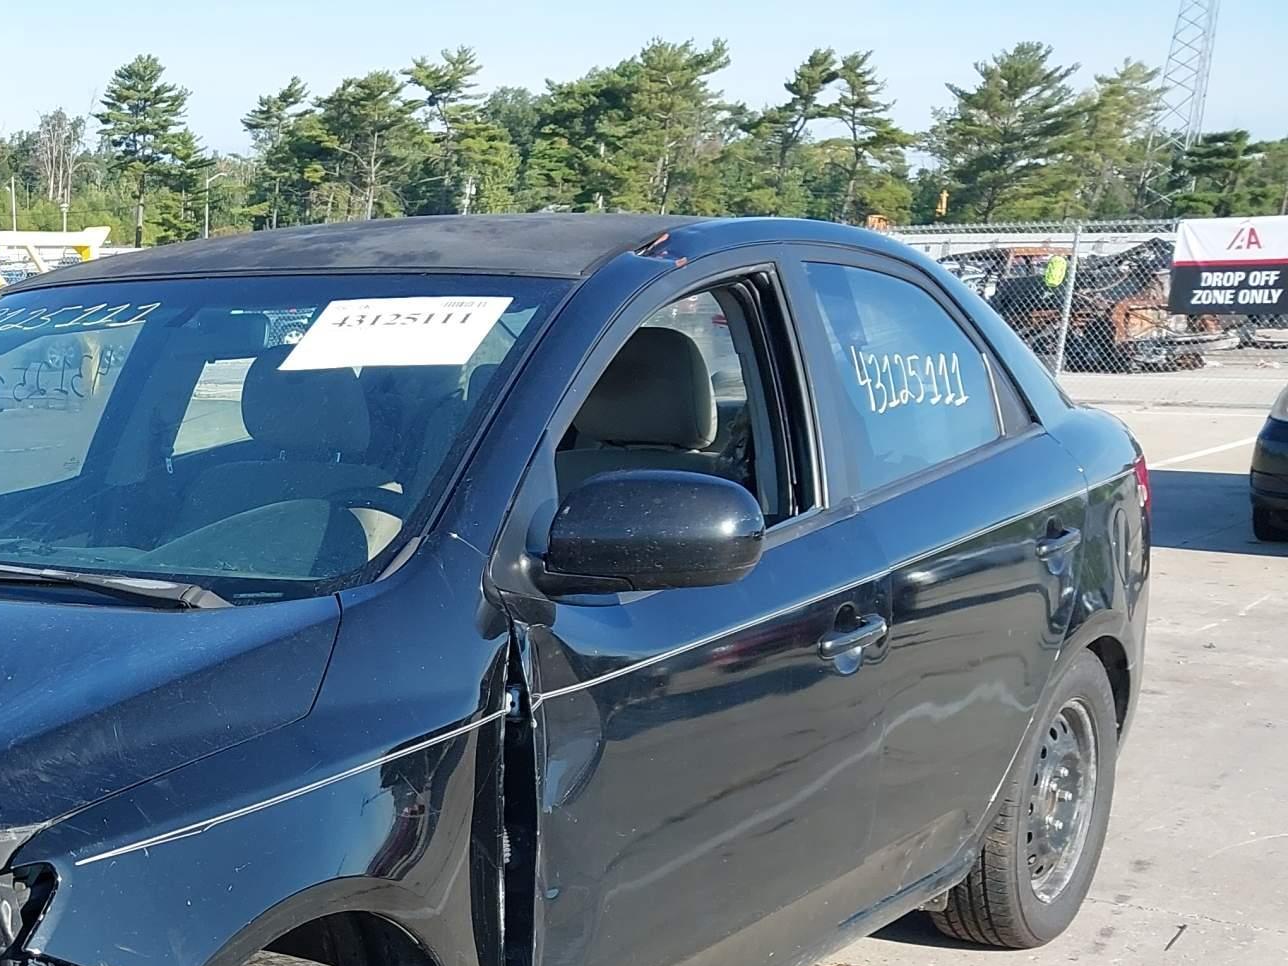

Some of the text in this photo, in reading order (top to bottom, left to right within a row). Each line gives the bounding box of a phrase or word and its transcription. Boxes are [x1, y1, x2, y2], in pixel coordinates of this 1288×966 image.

[1200, 270, 1281, 287] DROP OFF
[1190, 288, 1284, 305] ZONE ONLY
[331, 312, 472, 328] 43125111
[850, 345, 970, 414] 43125111
